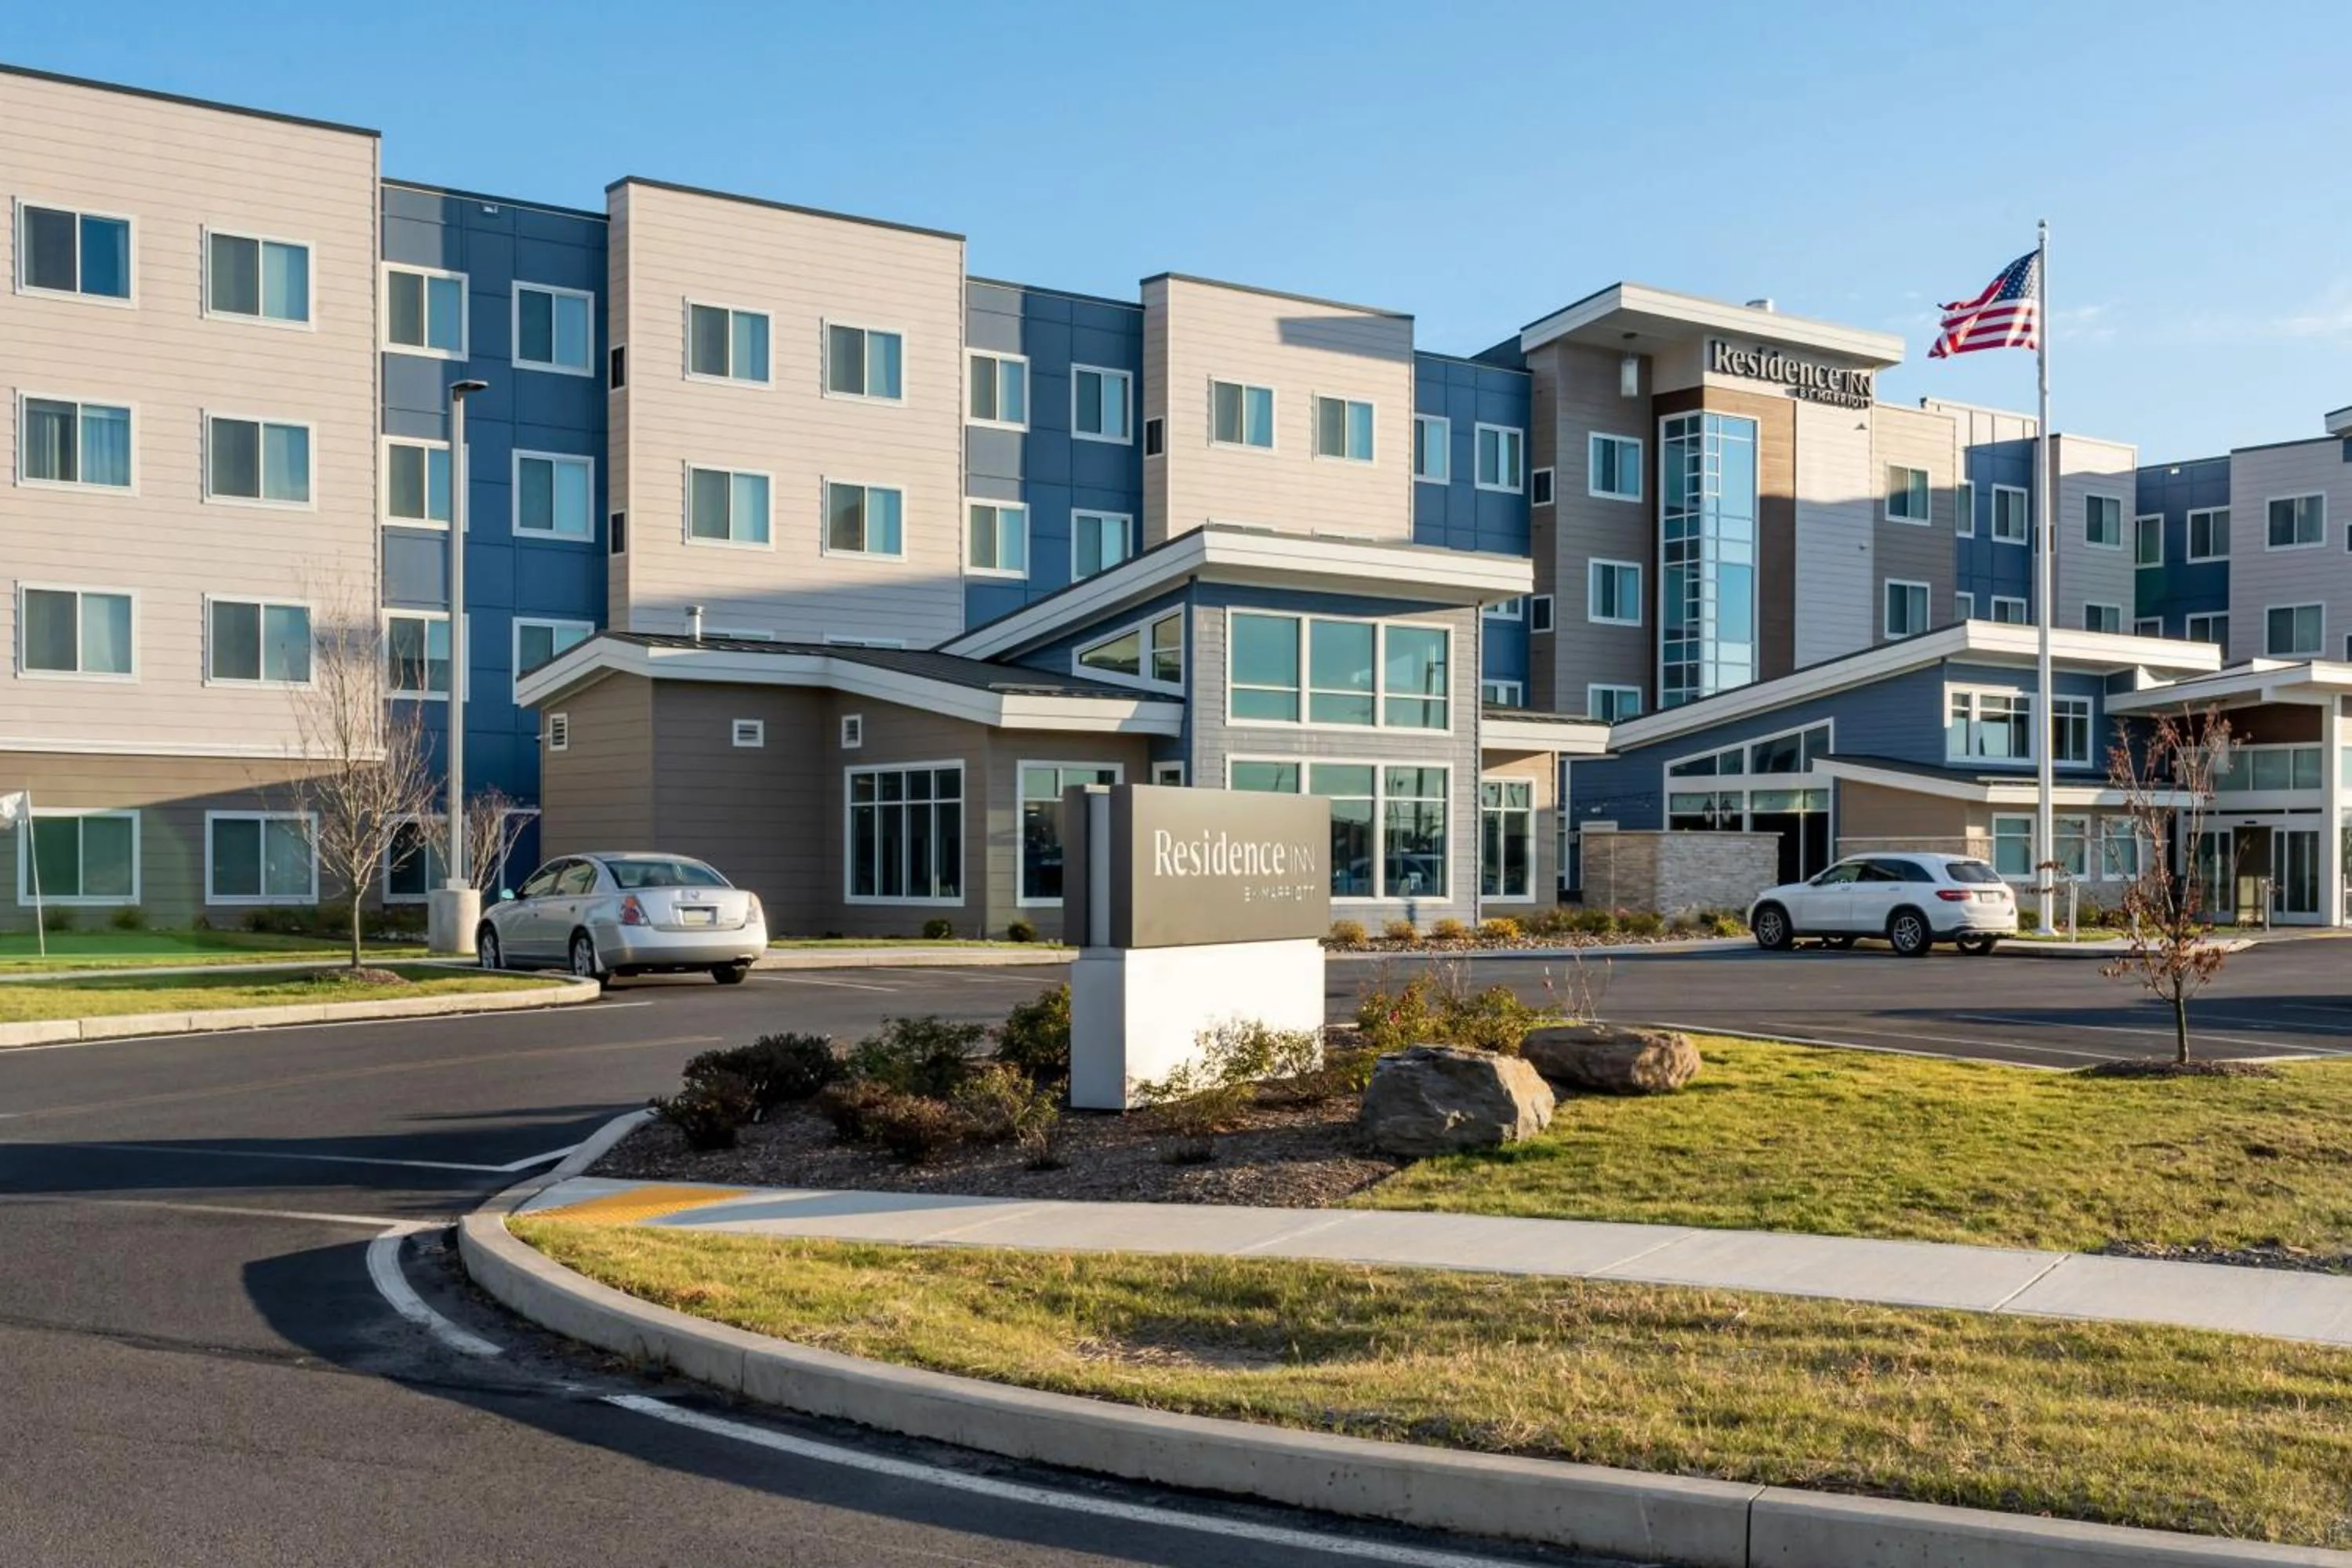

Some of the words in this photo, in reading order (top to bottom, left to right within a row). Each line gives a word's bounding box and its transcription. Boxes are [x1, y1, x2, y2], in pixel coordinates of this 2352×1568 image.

[1712, 341, 1840, 390] Residence
[1846, 369, 1871, 396] INN
[1799, 387, 1817, 399] BY
[1817, 389, 1871, 408] MARRIOTT
[1154, 828, 1286, 877] Residence
[1289, 840, 1316, 876] INN
[1243, 885, 1259, 902] B
